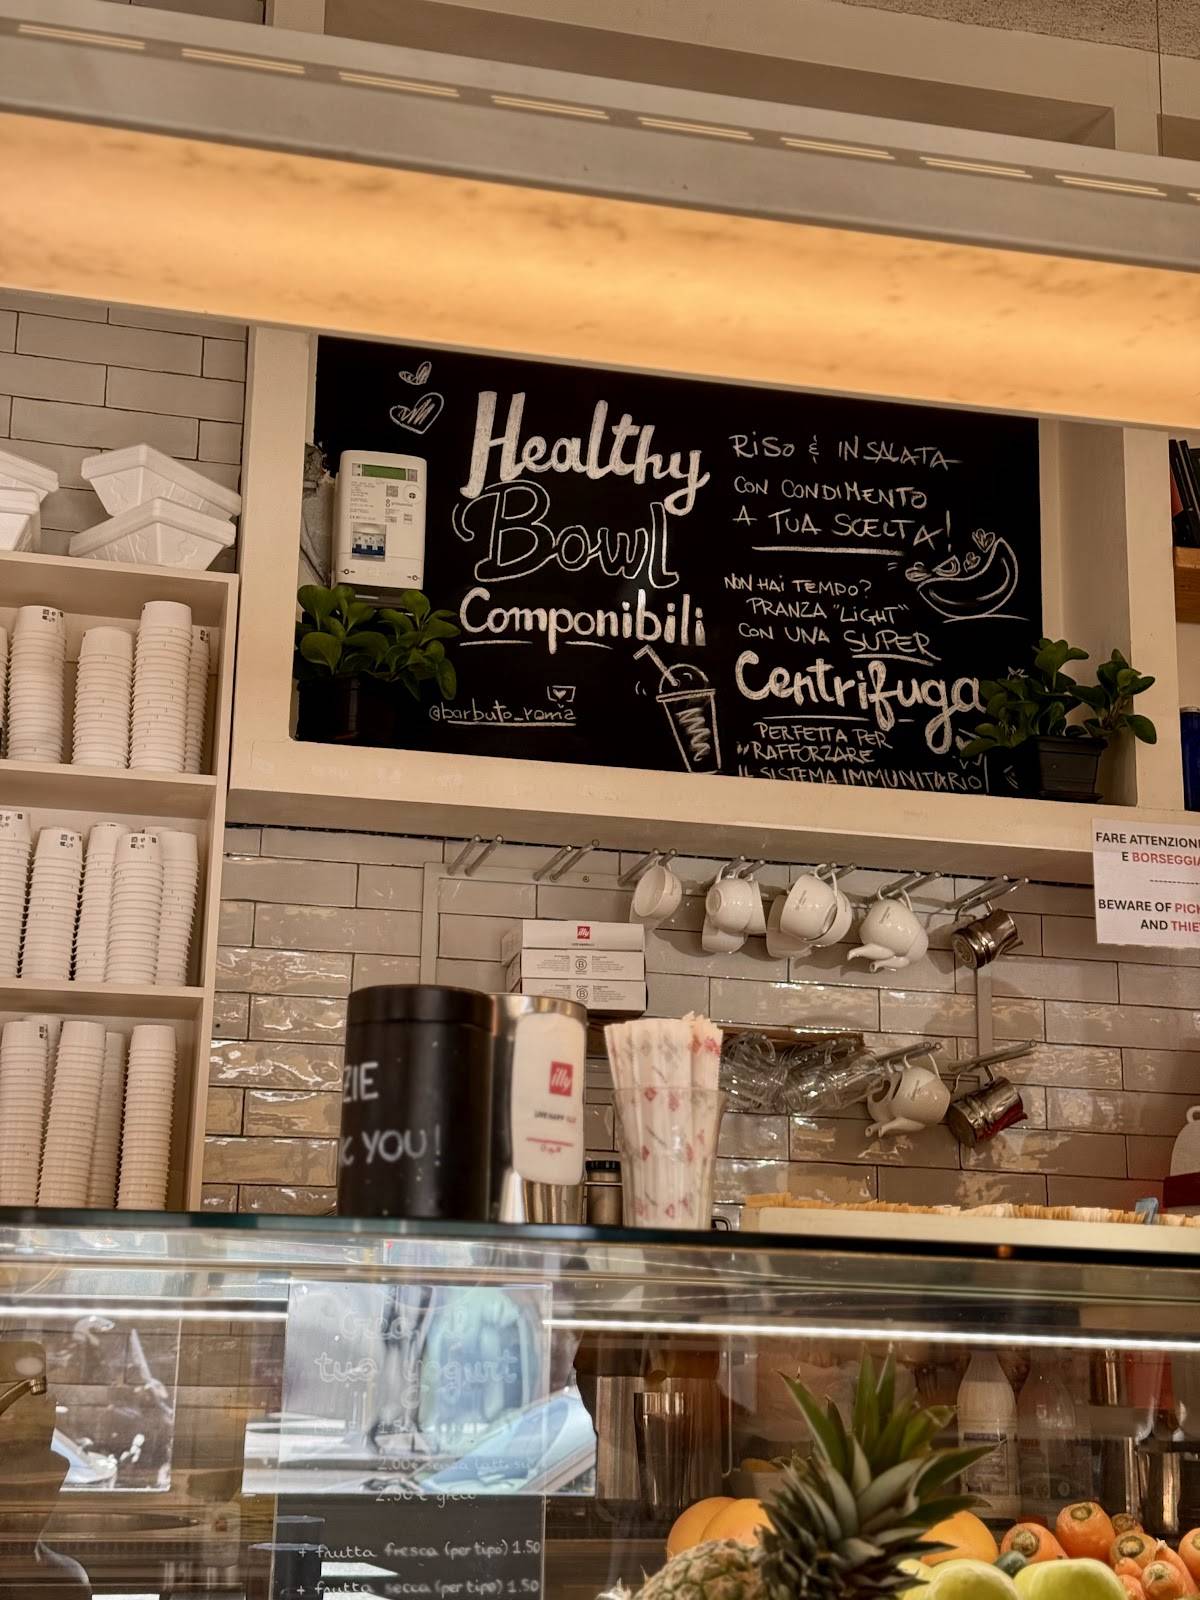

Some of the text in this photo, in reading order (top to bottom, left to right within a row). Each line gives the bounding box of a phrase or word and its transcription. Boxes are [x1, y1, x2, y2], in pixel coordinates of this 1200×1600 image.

[460, 391, 710, 516] Healthy
[782, 479, 927, 509] CONDIMENTO
[732, 505, 758, 526] A
[768, 508, 822, 535] TUA
[452, 480, 680, 589] Bowl
[792, 579, 872, 599] TEMPO?
[746, 597, 827, 619] PRANZA
[460, 588, 706, 654] Componibili
[784, 626, 830, 645] UNA
[844, 629, 942, 660] SUPER
[735, 650, 986, 754] Centrifuga
[753, 722, 893, 749] PERFETTA PER
[760, 767, 837, 784] SISTEMA
[1096, 832, 1126, 844] FARE
[1122, 852, 1128, 861] E
[1098, 899, 1152, 911] BEWARE
[1155, 902, 1171, 912] OF
[1140, 920, 1168, 930] AND
[551, 1067, 572, 1091] illy
[361, 1124, 441, 1166] YOU!
[315, 1544, 376, 1558] frutta
[384, 1542, 439, 1557] fresca
[445, 1541, 471, 1560] (per
[474, 1539, 508, 1559] tipo)
[512, 1540, 540, 1554] 1.50
[315, 1581, 374, 1595] frutta
[385, 1583, 431, 1594] secca
[435, 1580, 463, 1598] (per
[466, 1579, 503, 1595] tipo)
[507, 1578, 539, 1592] 1.50
